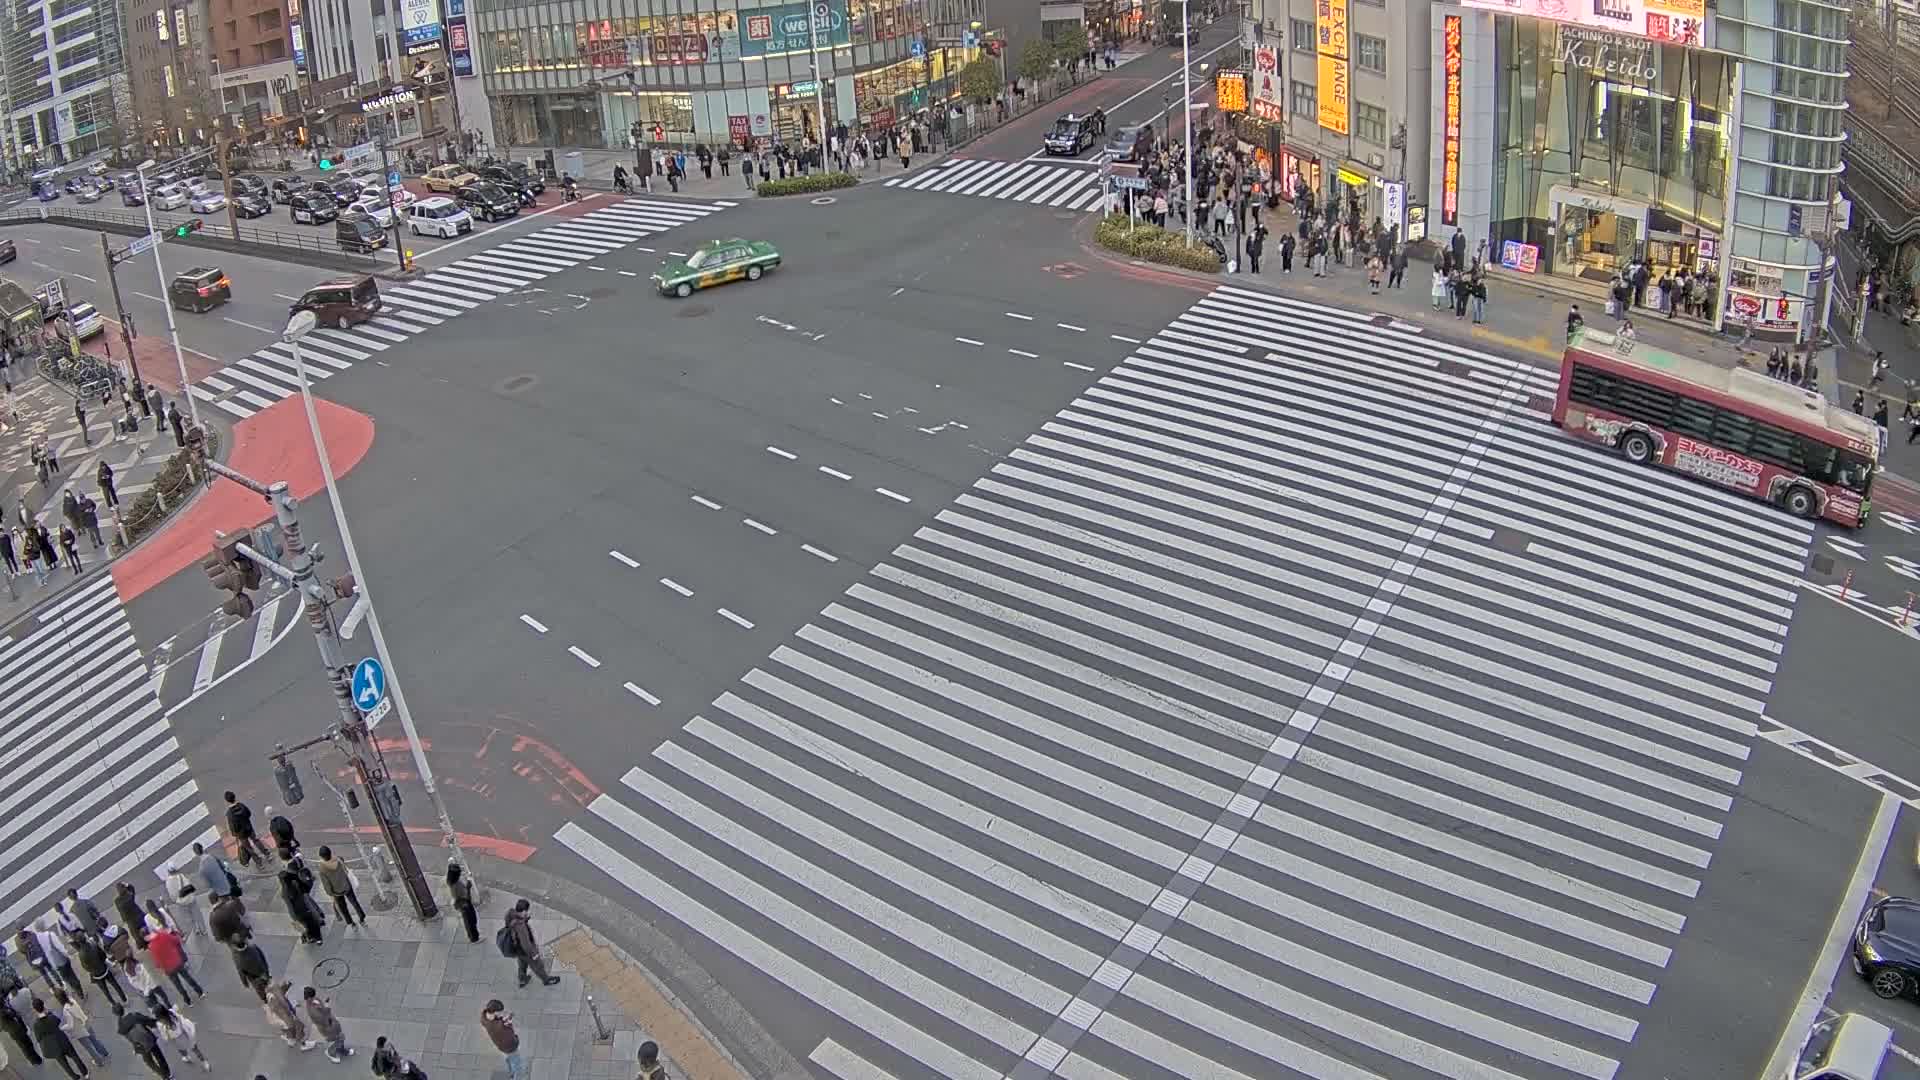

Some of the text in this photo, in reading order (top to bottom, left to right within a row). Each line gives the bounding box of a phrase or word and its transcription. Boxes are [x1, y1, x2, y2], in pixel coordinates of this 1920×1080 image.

[1333, 7, 1345, 105] EXCHANGE
[1550, 38, 1657, 80] Kaleido
[1626, 37, 1652, 50] SLOT
[732, 117, 746, 125] TAX
[1678, 437, 1764, 476] ヨドバシカメラ
